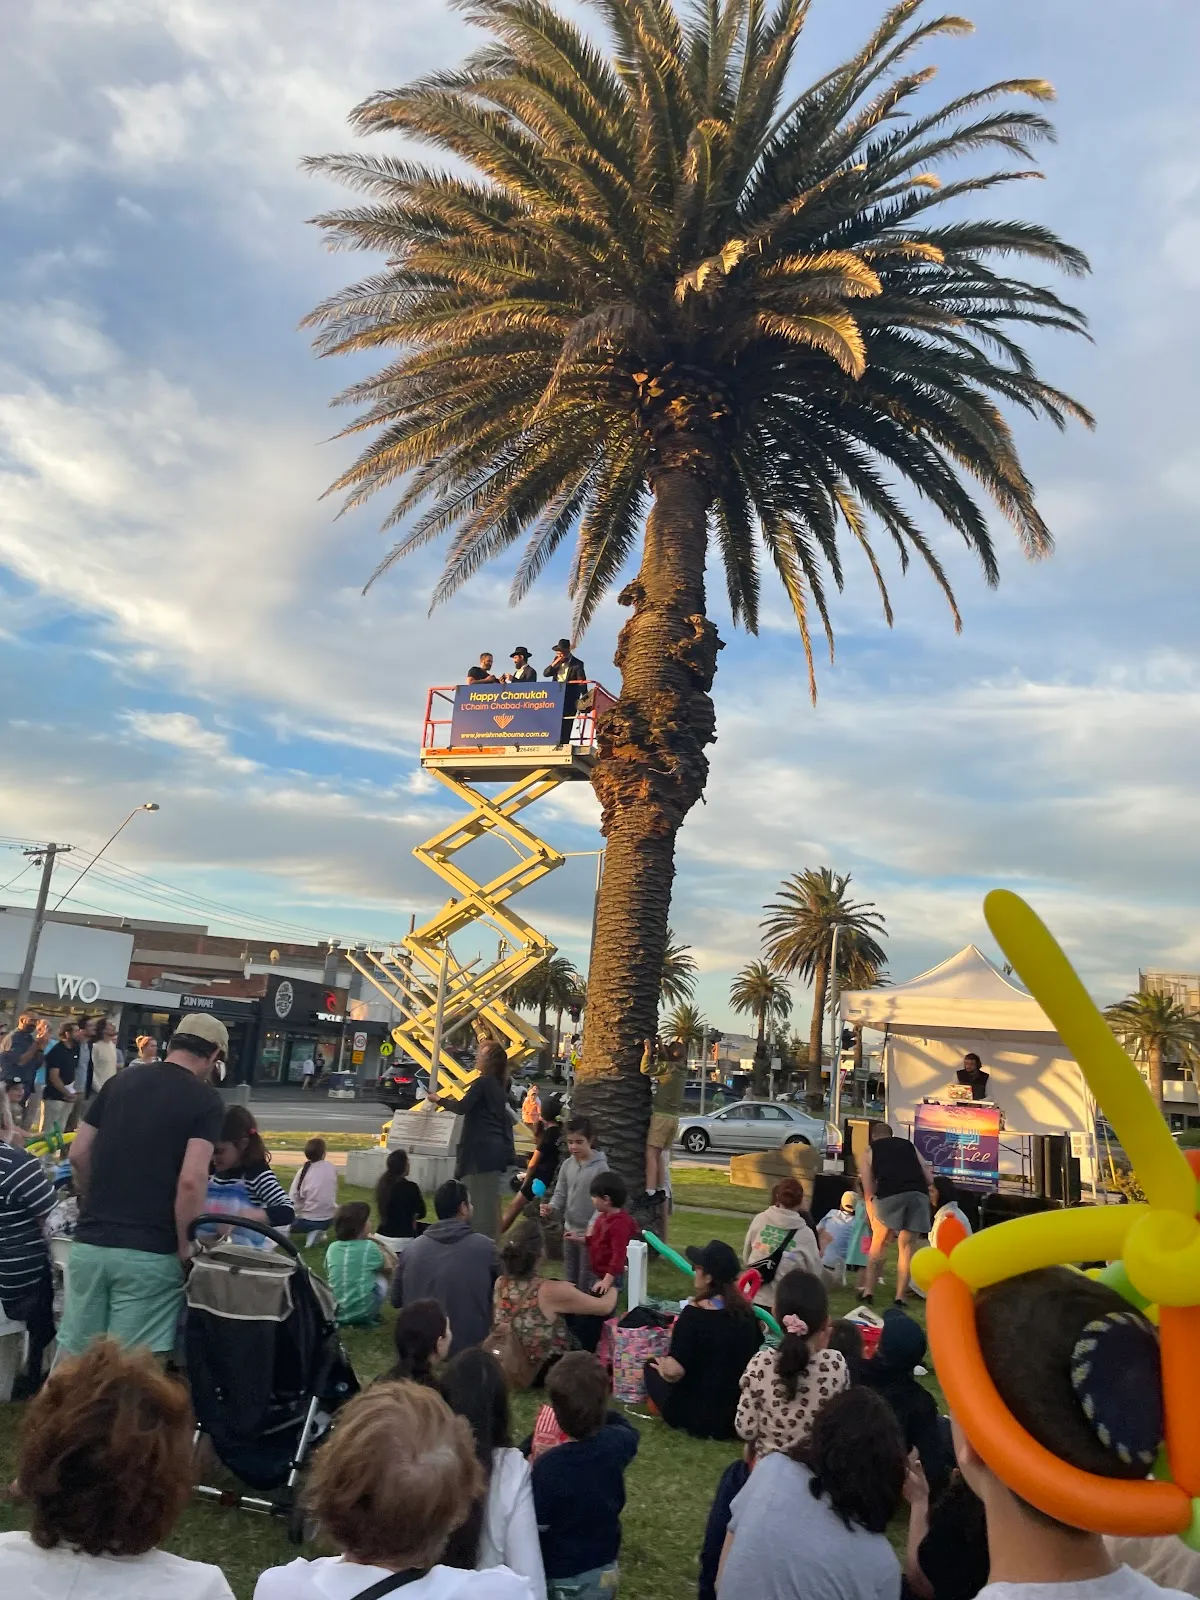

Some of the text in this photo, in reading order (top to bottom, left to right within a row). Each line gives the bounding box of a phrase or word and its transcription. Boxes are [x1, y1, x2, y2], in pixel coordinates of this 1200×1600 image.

[470, 690, 548, 703] Happy Chanukah
[461, 702, 489, 711] L'Chaim
[460, 731, 549, 739] www.jewishmelbourne.com.au
[183, 996, 213, 1009] SUN WAH
